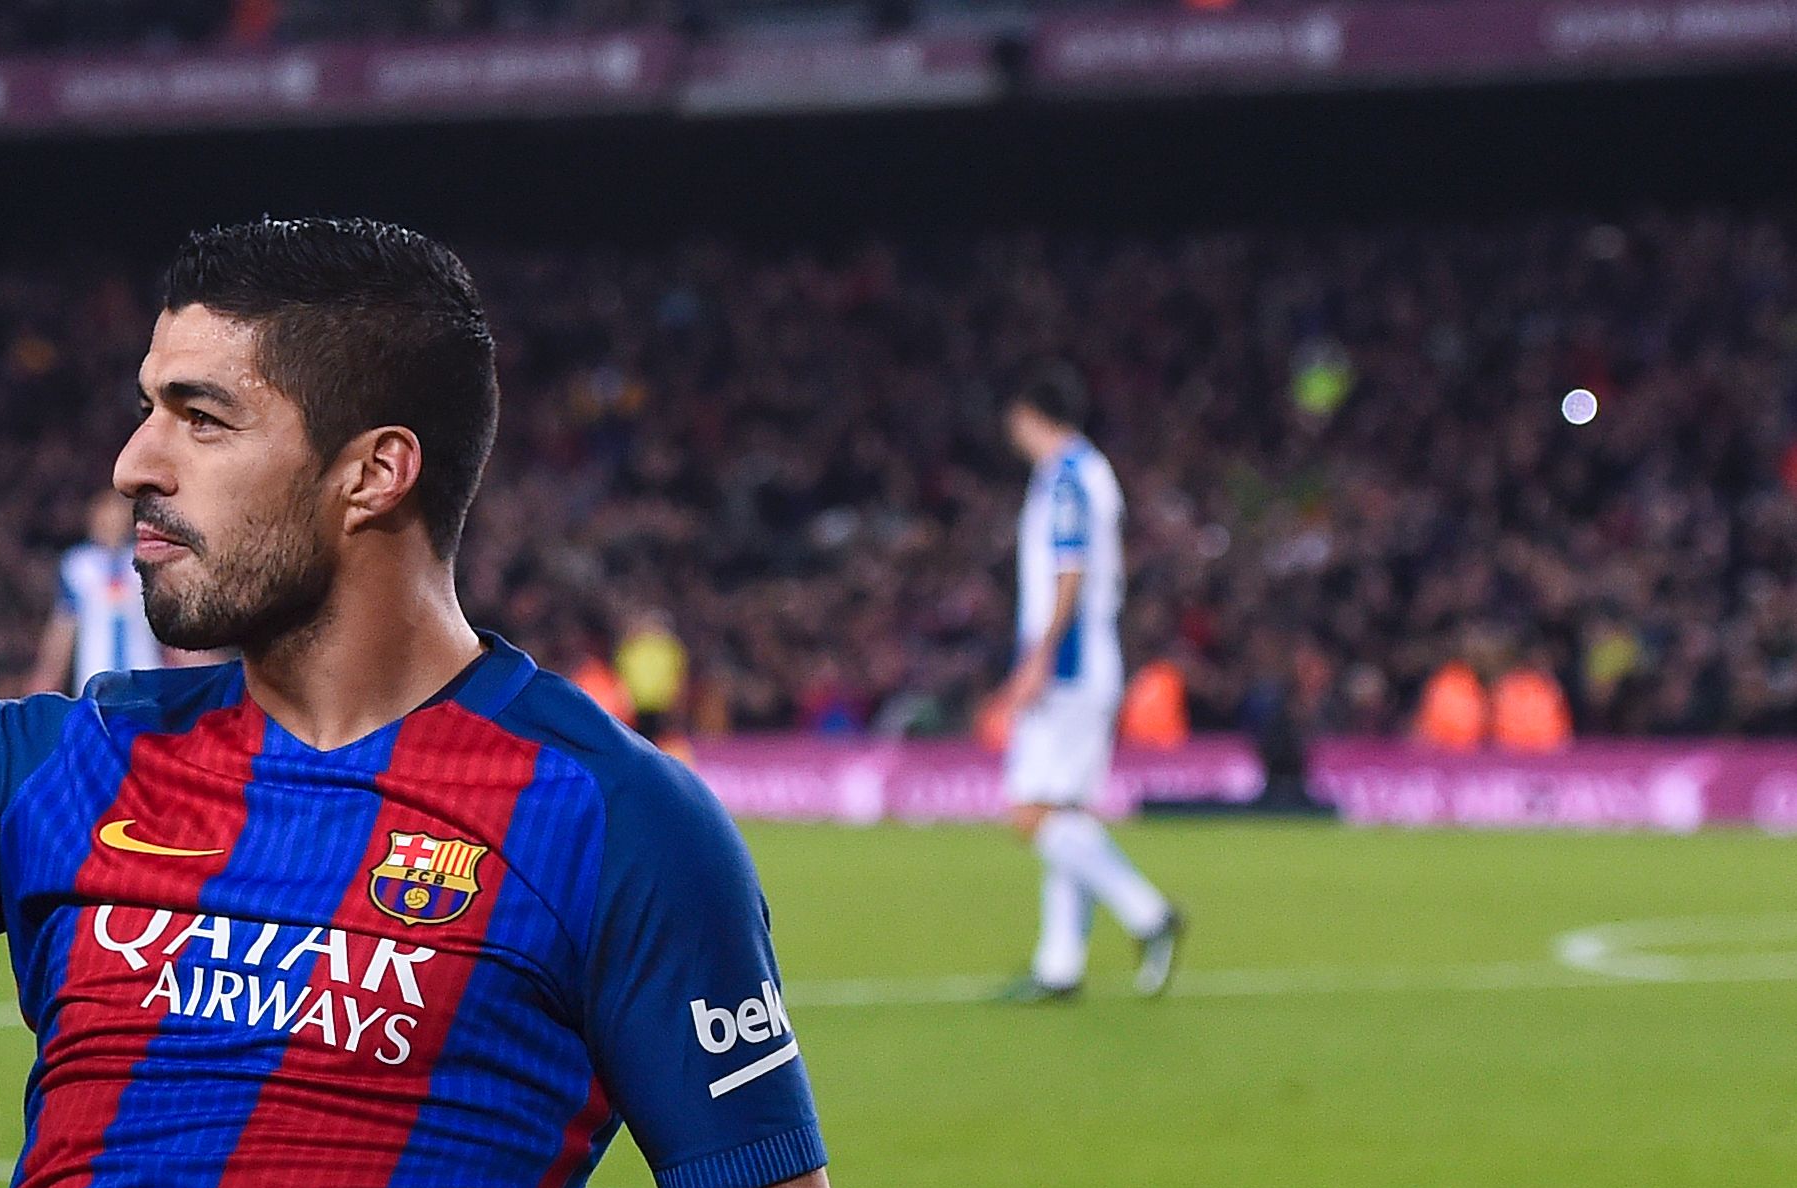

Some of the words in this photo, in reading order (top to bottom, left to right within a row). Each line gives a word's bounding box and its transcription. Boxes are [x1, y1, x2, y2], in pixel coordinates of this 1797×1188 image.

[404, 868, 447, 886] FCB
[140, 960, 418, 1065] AIRWAYS
[689, 979, 791, 1054] bek
